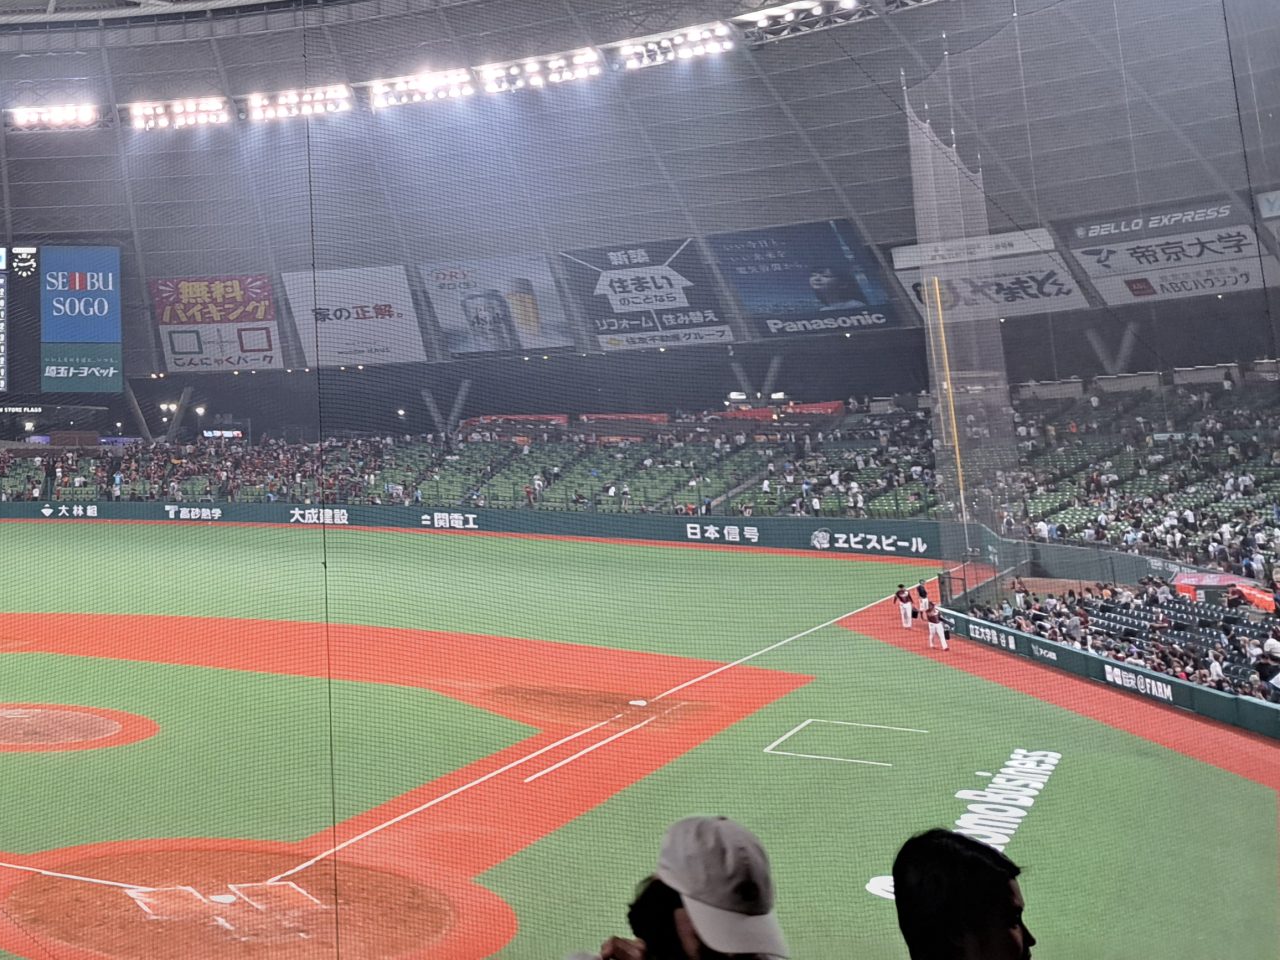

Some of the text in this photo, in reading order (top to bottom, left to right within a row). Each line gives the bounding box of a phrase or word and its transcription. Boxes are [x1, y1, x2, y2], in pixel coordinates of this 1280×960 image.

[1088, 205, 1232, 238] BELLO EXPRESS
[608, 248, 650, 265] 新築
[1126, 231, 1253, 265] 帝京大学
[46, 272, 113, 291] SEIBU
[177, 279, 244, 303] 無料
[608, 275, 674, 294] 住まい
[53, 297, 108, 316] SOGO
[618, 294, 677, 306] のことなら
[162, 300, 269, 323] バイキング
[312, 303, 404, 322] 家の正解。
[595, 310, 719, 330] リフォーム 住み替え
[766, 311, 887, 333] Panasonic
[44, 366, 119, 378] 埼玉トヨペット
[58, 505, 98, 517] 大林組
[289, 507, 349, 525] 大成建設
[433, 512, 479, 529] 関電工
[687, 523, 760, 543] 日本信号
[834, 533, 928, 553] ヱビスビール
